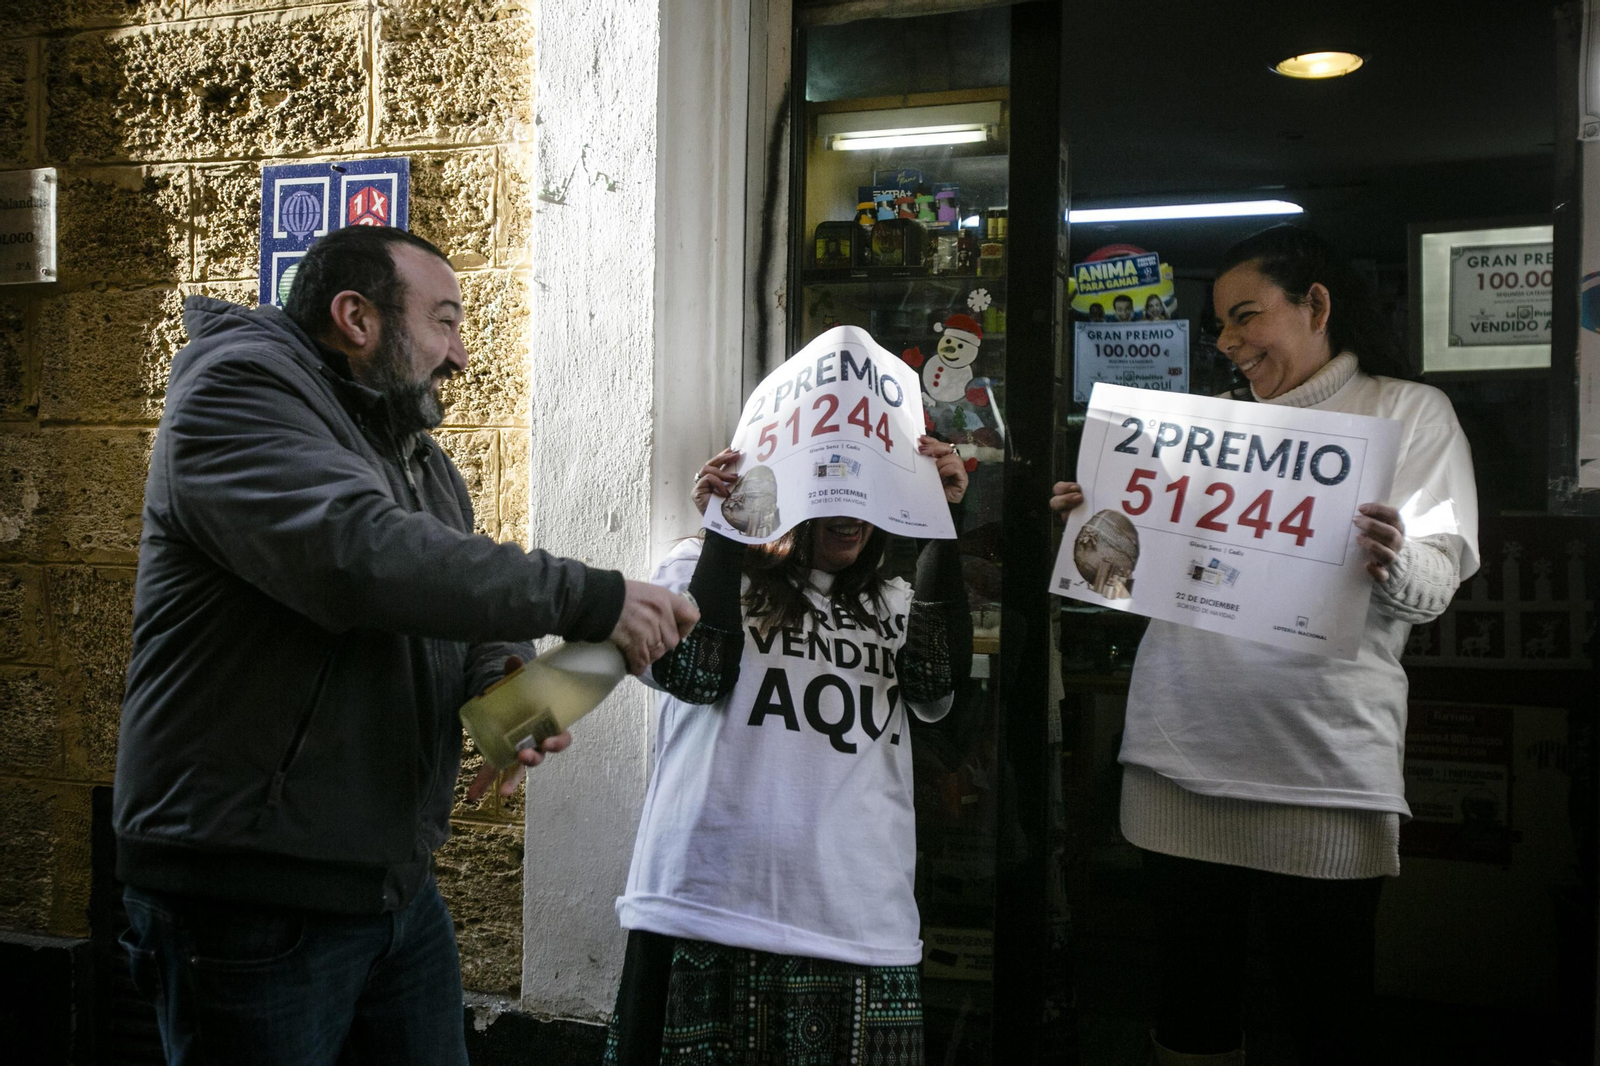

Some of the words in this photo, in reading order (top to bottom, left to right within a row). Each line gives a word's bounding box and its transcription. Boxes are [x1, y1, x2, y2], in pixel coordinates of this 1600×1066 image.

[0, 232, 33, 245] LOGO
[1467, 253, 1517, 269] GRAN
[1078, 259, 1138, 283] ANIMA
[1079, 280, 1105, 293] PARA
[1105, 276, 1139, 289] GANAR
[1087, 330, 1122, 341] GRAN
[1126, 329, 1174, 340] PREMIO
[1470, 319, 1539, 333] VENDIDO
[1094, 343, 1160, 358] 100.000
[773, 349, 904, 414] PREMIO
[756, 393, 894, 463] 51244
[1151, 421, 1352, 486] PREMIO
[818, 489, 828, 497] DE
[830, 488, 868, 500] DICIEMBRE
[1121, 467, 1317, 548] 51244
[1175, 591, 1186, 600] 22
[1187, 594, 1198, 603] DE
[1199, 597, 1241, 612] DICIEMBRE
[1176, 601, 1200, 613] SORTEO
[1201, 607, 1209, 615] DE
[1209, 609, 1237, 620] NAVIDAD
